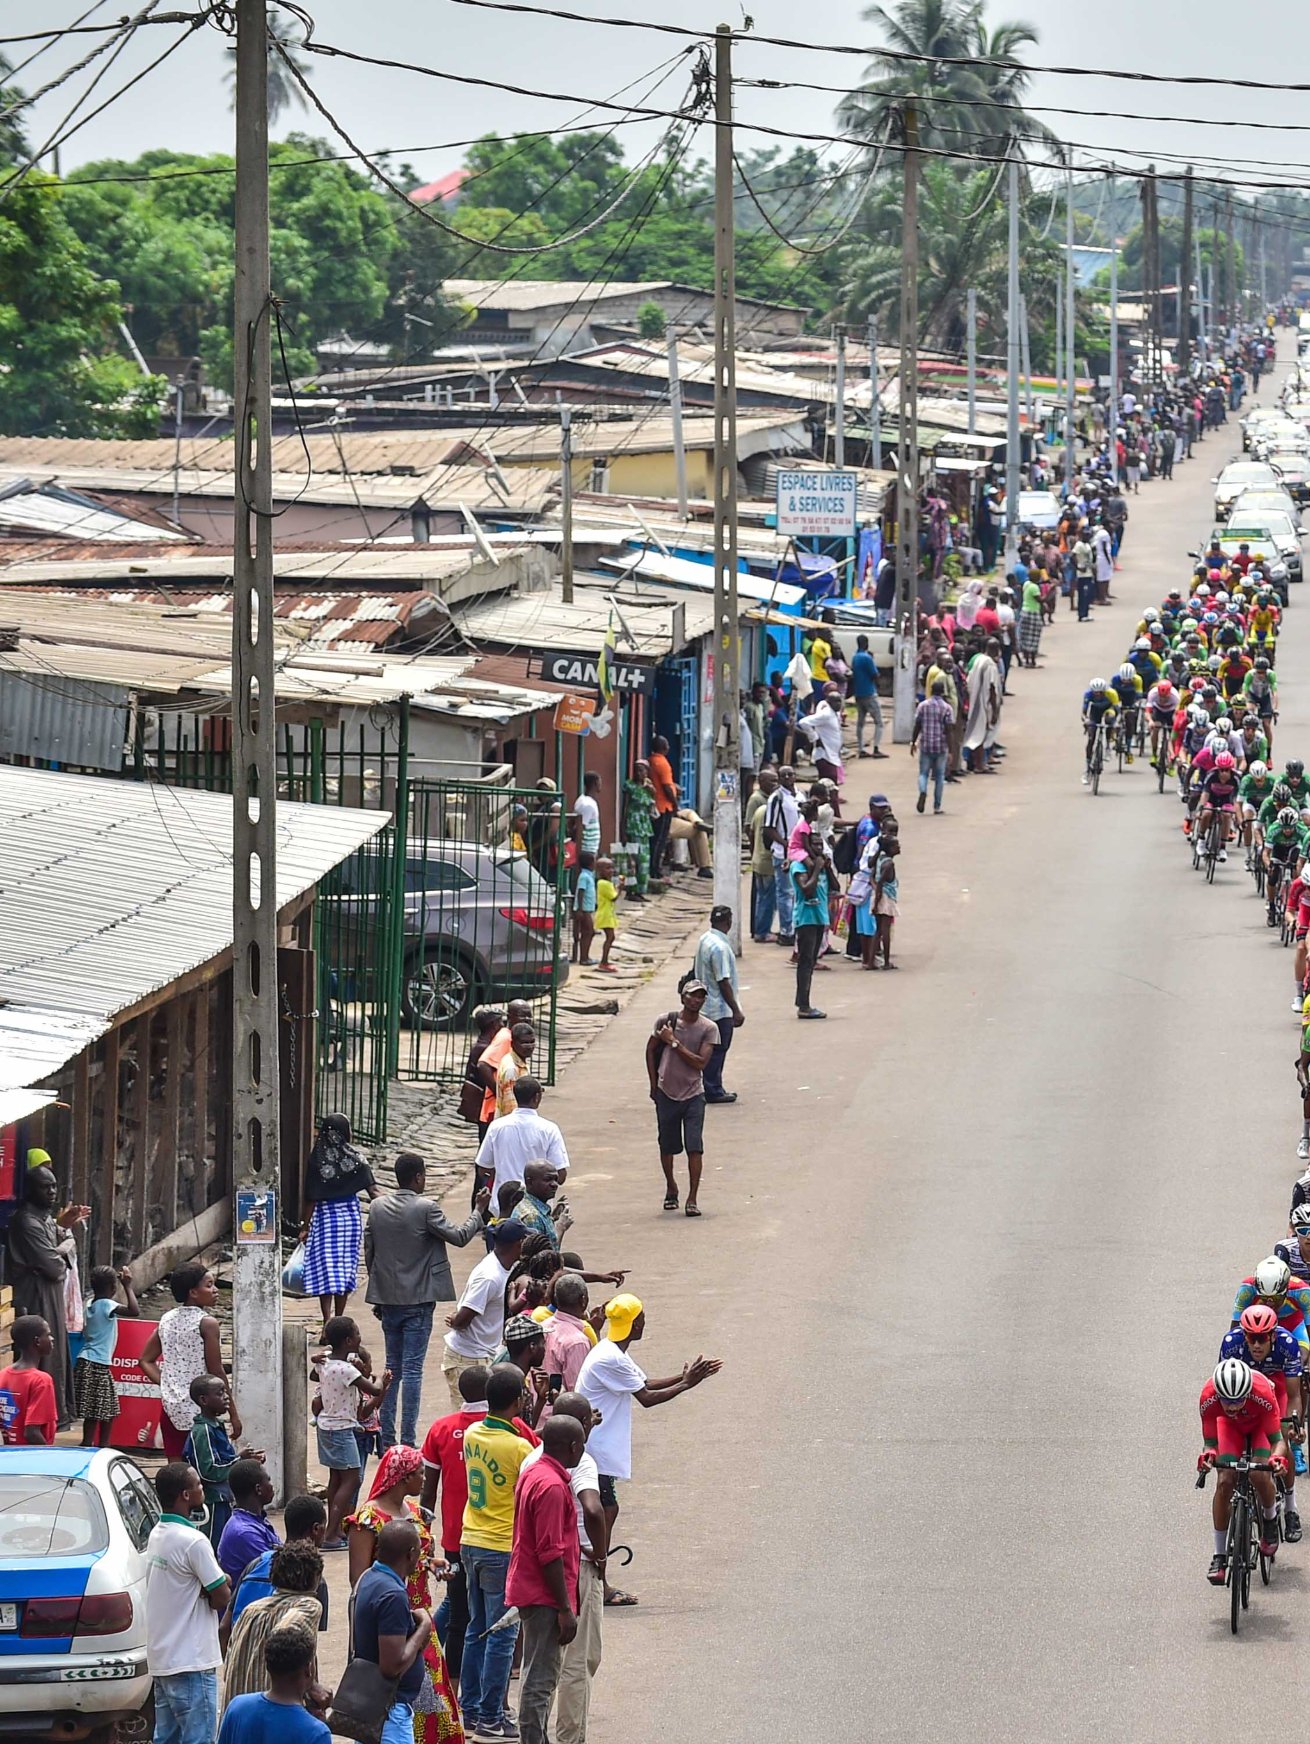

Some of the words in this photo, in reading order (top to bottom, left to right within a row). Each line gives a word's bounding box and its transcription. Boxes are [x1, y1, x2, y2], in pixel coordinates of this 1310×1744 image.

[781, 474, 818, 490] ESPACE
[820, 475, 853, 492] LIVRES
[789, 496, 796, 512] &
[799, 497, 845, 513] SERVICES
[120, 1373, 142, 1382] CODE
[468, 1466, 487, 1511] 9
